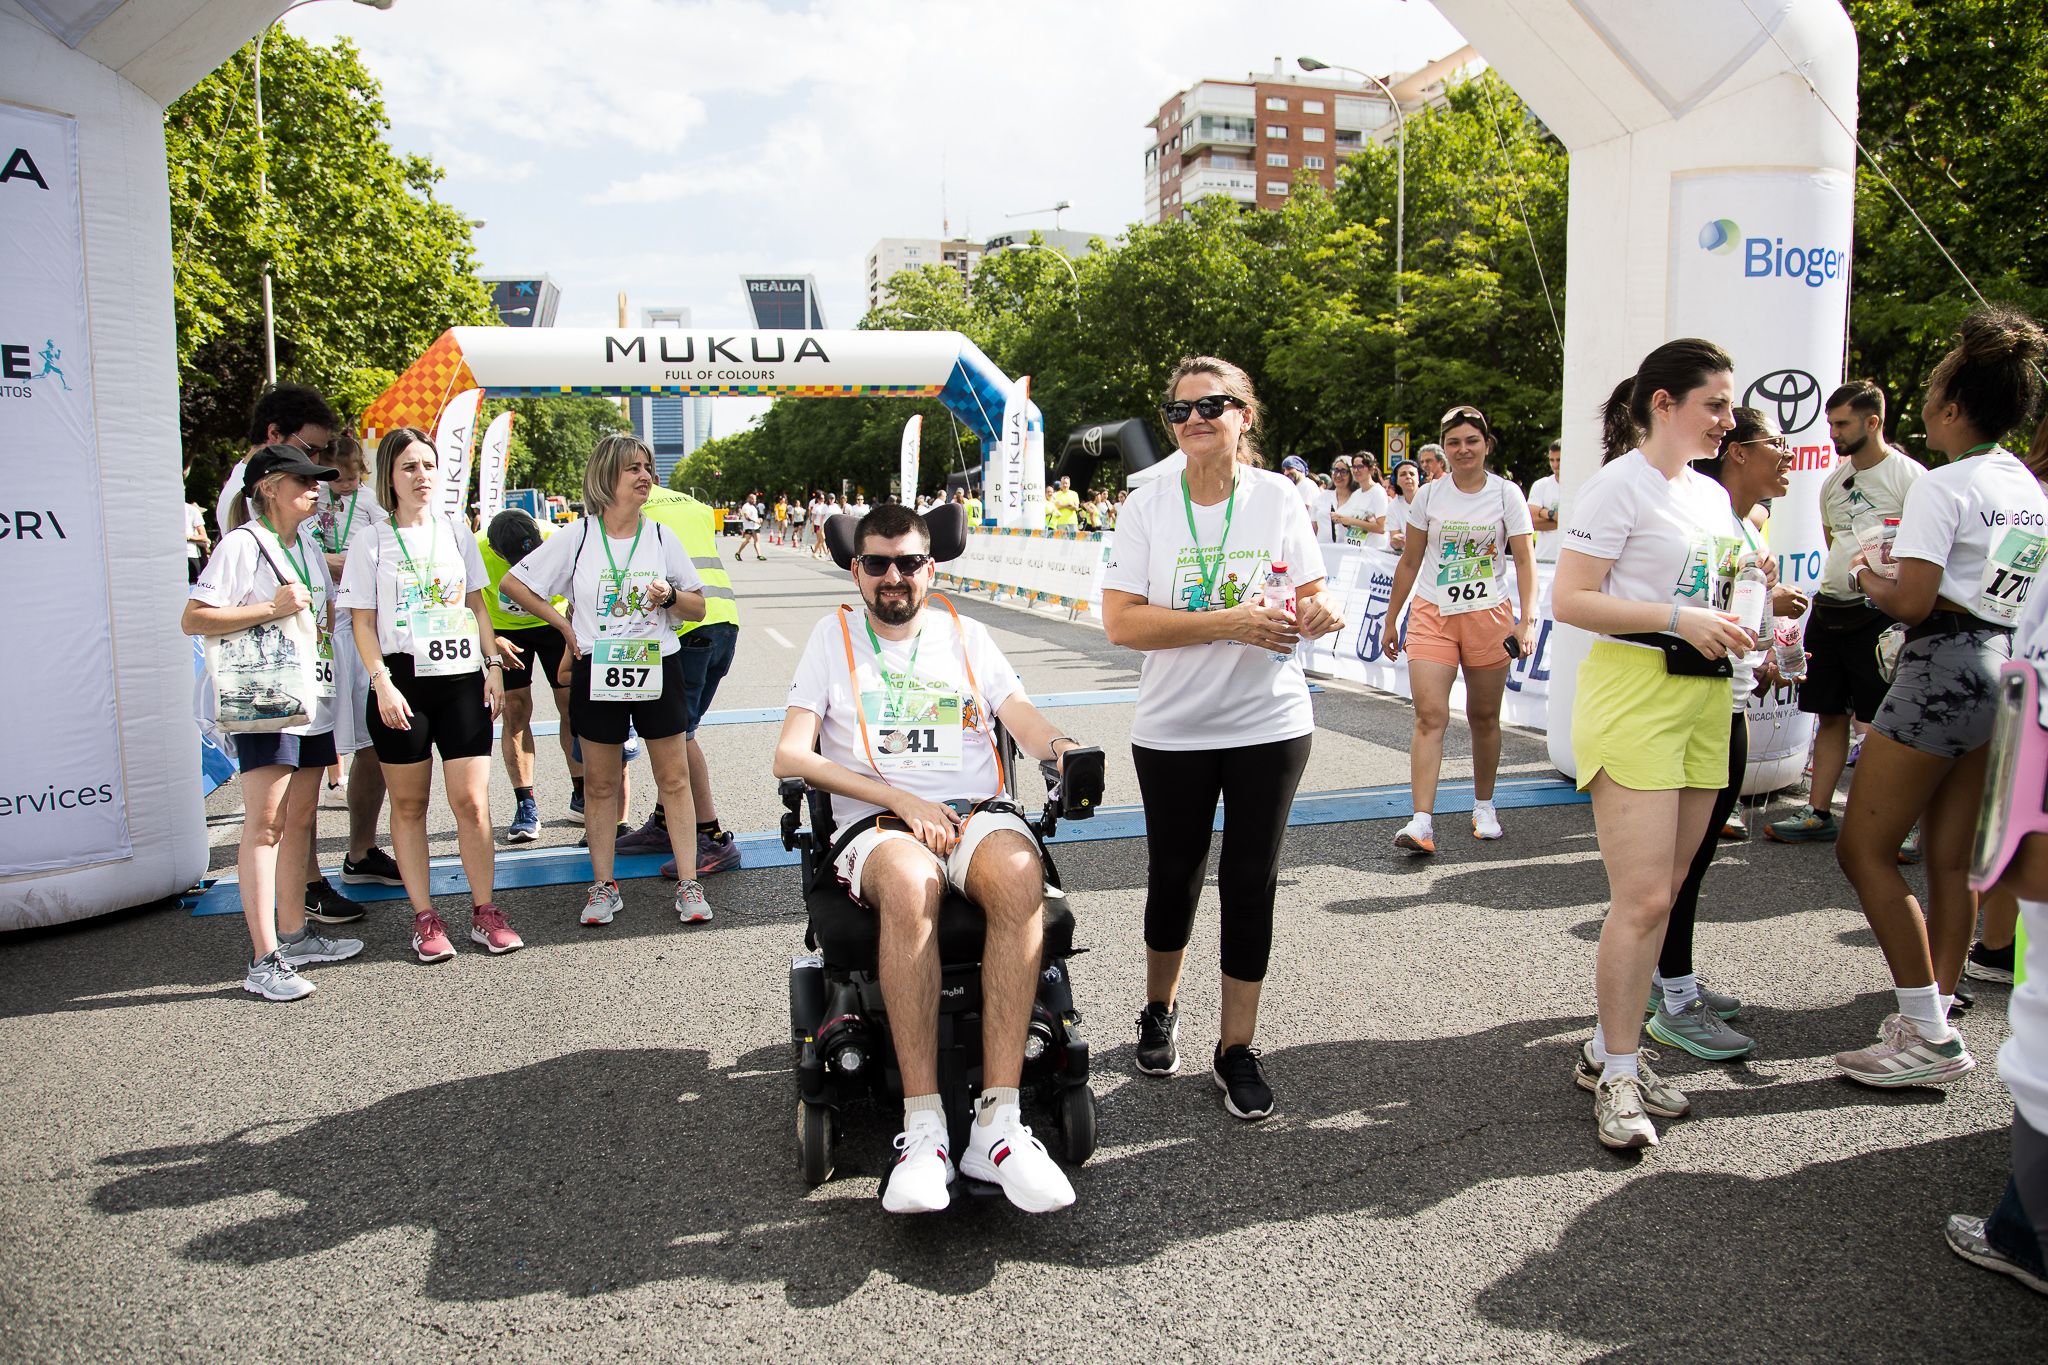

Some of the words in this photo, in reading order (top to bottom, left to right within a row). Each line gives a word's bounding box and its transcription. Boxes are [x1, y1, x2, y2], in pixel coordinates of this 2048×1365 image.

[1745, 238, 1844, 287] Biogen
[605, 336, 830, 363] MUKUA
[1, 345, 31, 379] E
[665, 370, 692, 380] FULL
[697, 370, 713, 380] OF
[717, 370, 775, 380] COLOURS
[1009, 412, 1020, 507] MUKUA
[1229, 550, 1254, 559] CON
[1257, 550, 1270, 558] LA
[1448, 581, 1488, 603] 962
[428, 638, 472, 661] 858
[608, 644, 648, 662] ELA
[605, 667, 650, 688] 857
